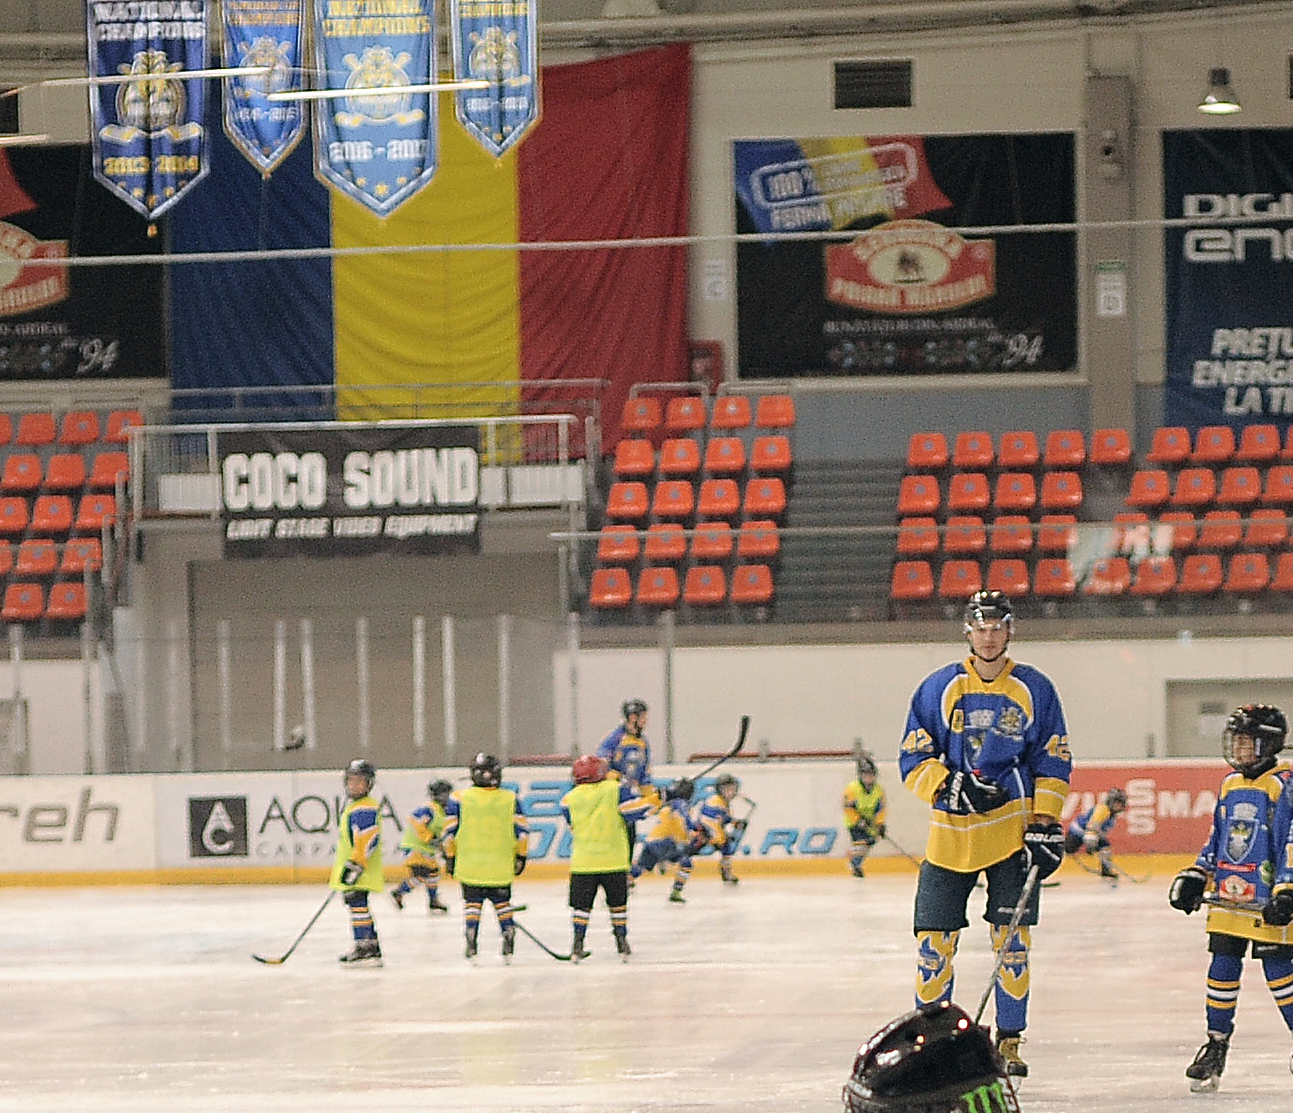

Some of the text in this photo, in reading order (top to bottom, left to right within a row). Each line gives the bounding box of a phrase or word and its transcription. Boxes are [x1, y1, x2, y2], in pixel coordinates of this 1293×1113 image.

[97, 22, 205, 40] CHAMPIONS
[322, 16, 430, 36] CHAMPIONS
[1225, 386, 1264, 415] LA
[222, 446, 479, 512] COCO SOUND
